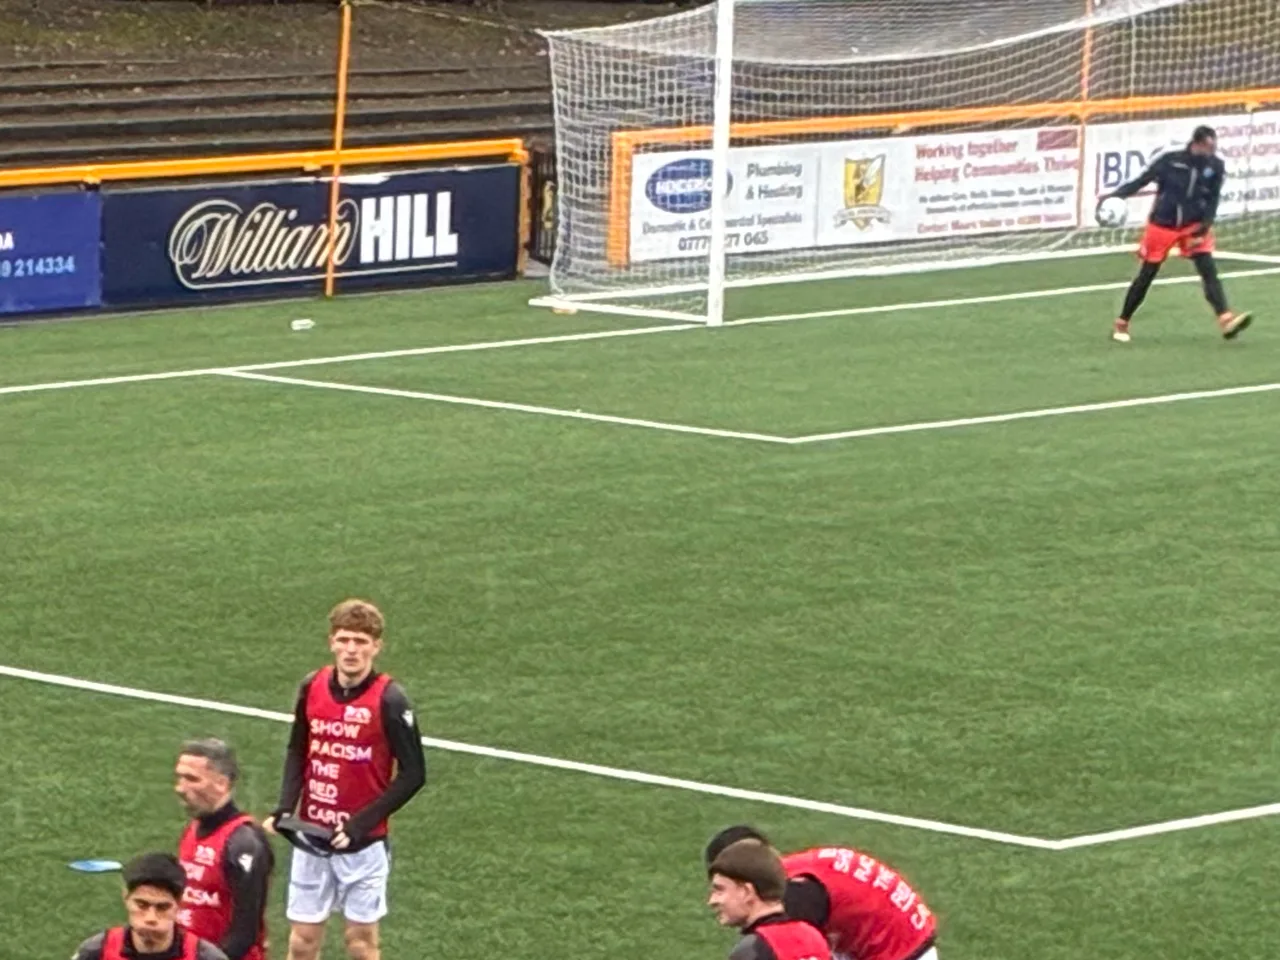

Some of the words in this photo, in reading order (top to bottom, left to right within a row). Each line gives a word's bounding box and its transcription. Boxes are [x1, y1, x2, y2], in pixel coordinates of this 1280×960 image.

[915, 143, 964, 161] Working
[967, 138, 1019, 158] together
[746, 161, 803, 178] Plumbing
[914, 164, 960, 184] Helping
[962, 158, 1040, 179] Communities
[744, 185, 754, 201] &
[757, 183, 804, 199] Heating
[641, 220, 686, 235] Domestic
[168, 198, 361, 288] William
[360, 191, 458, 264] HILL
[310, 719, 361, 739] SHOW
[309, 739, 373, 761] RACISM
[311, 760, 341, 780] THE
[309, 778, 339, 801] RED
